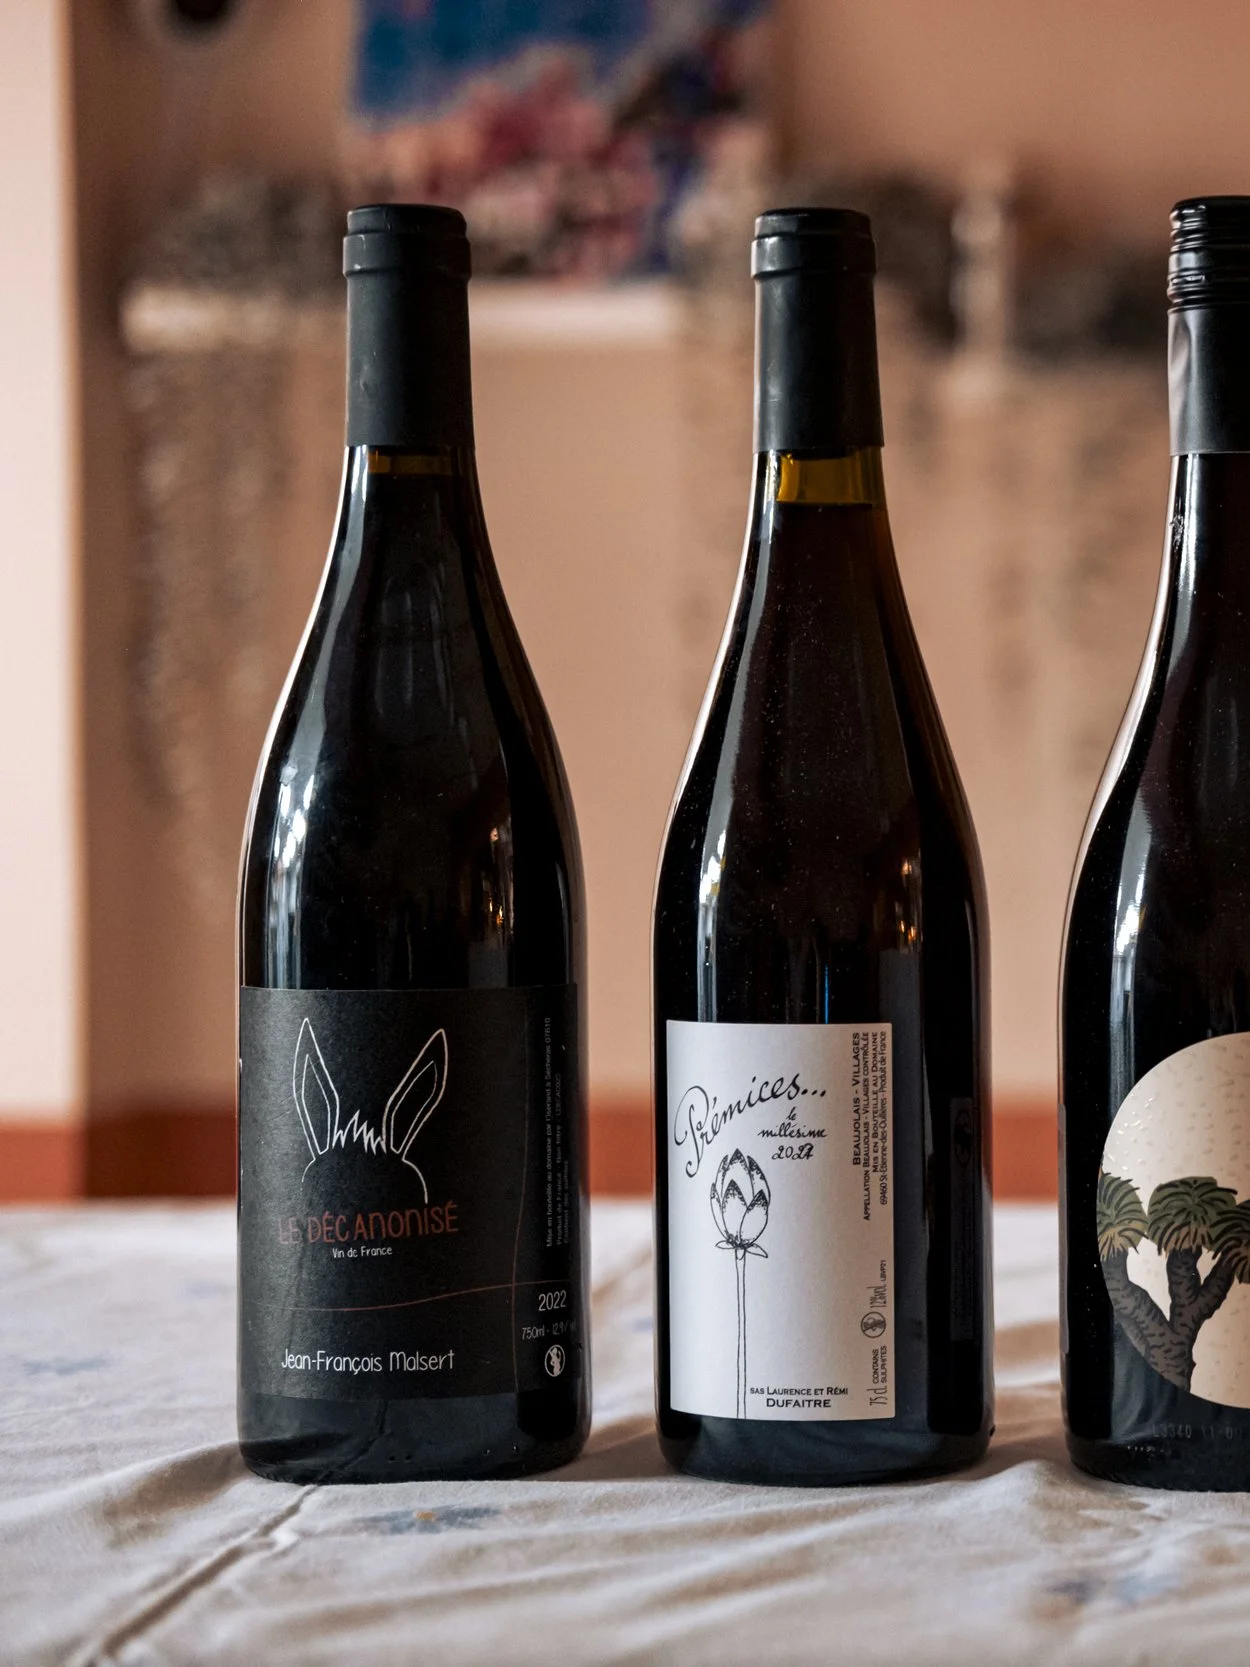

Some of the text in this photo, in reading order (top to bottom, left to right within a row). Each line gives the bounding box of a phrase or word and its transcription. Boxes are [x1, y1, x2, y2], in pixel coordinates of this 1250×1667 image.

[879, 1031, 887, 1055] France
[852, 1032, 861, 1087] VILLAGES
[879, 1056, 887, 1065] de
[871, 1074, 879, 1088] AU
[879, 1066, 888, 1093] Produit
[862, 1078, 870, 1115] VILLAGES
[786, 1106, 797, 1121] le
[871, 1090, 879, 1139] BOUTEILLE
[758, 1122, 828, 1139] millésime
[852, 1097, 861, 1165] BEAUJOLAIS
[545, 1137, 553, 1170] domaine
[862, 1121, 870, 1168] BEAUJOLAIS
[872, 1141, 879, 1153] EN
[880, 1182, 888, 1205] 69460
[278, 1216, 301, 1246] LE
[546, 1228, 554, 1247] Mise
[332, 1245, 393, 1258] Vin de France
[538, 1290, 567, 1312] 2022
[521, 1324, 546, 1341] 750ml
[281, 1348, 455, 1376] Jean-François Malsert
[880, 1345, 888, 1384] SULPHITES
[766, 1386, 812, 1396] LAURENCE
[813, 1387, 824, 1395] ET
[826, 1385, 848, 1395] RÉMI
[869, 1396, 887, 1406] 75
[766, 1398, 832, 1409] DUFAITRE
